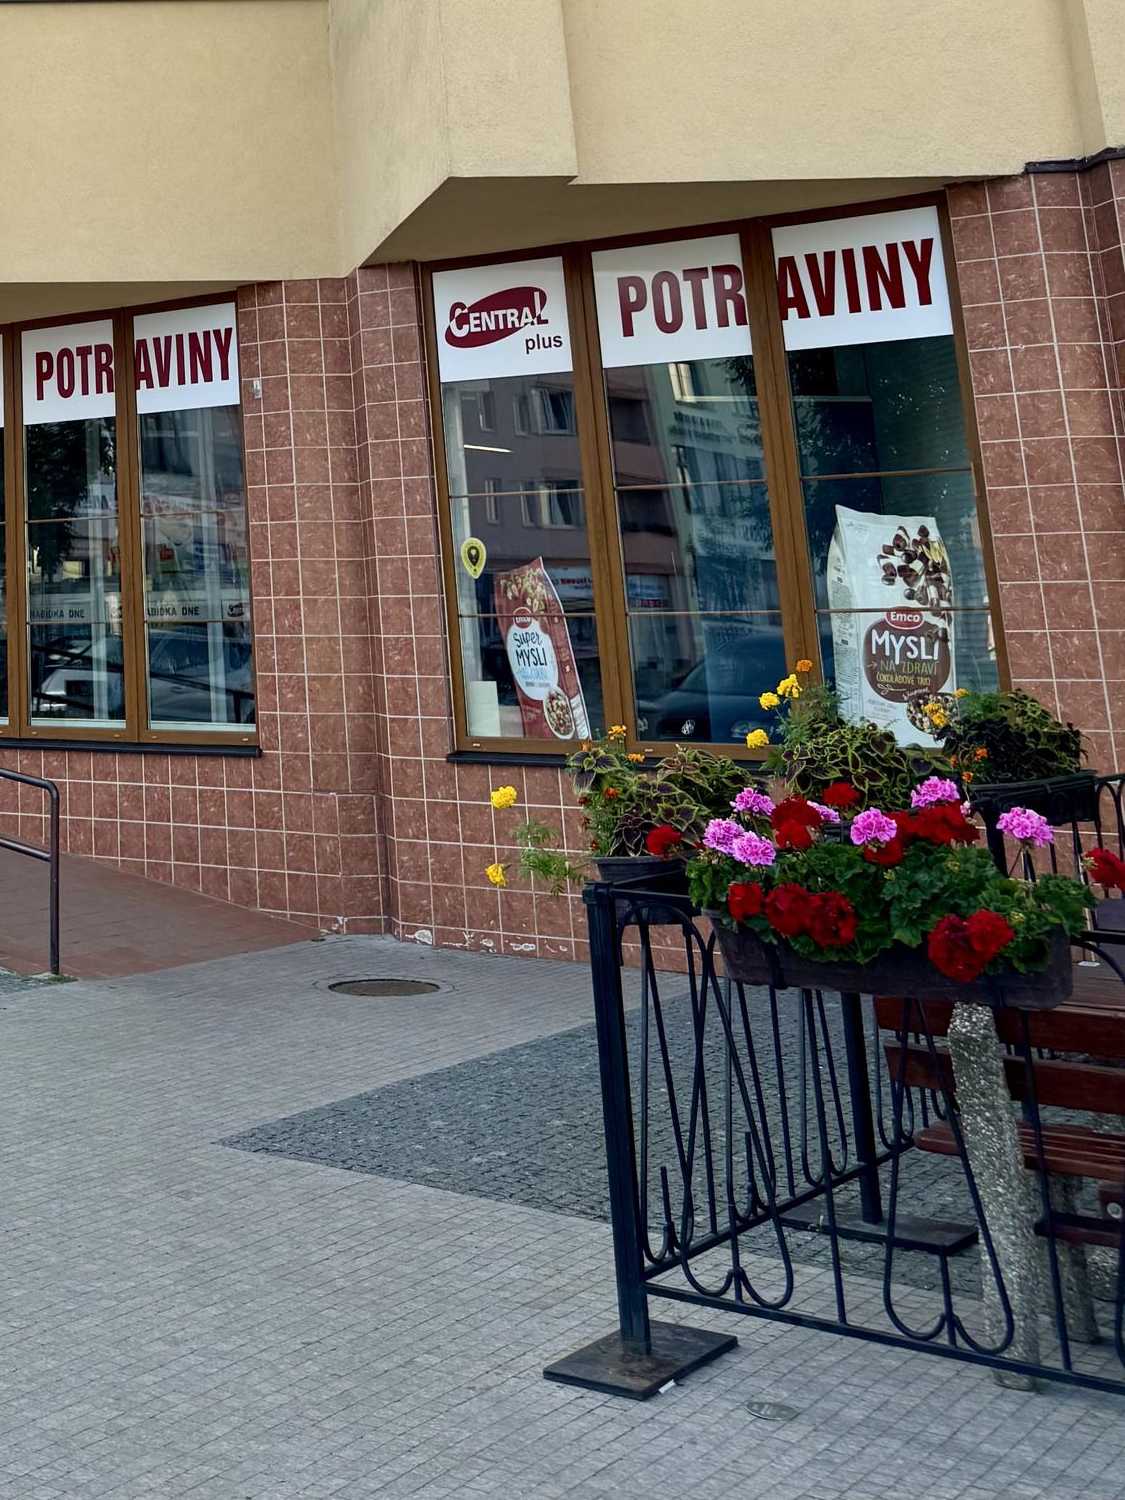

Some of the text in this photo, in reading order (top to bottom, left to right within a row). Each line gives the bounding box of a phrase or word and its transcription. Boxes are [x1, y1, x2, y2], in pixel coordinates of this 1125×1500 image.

[449, 290, 549, 338] CENTRAL
[524, 332, 563, 354] plus
[182, 606, 200, 616] DNE
[890, 611, 921, 622] Emco
[513, 631, 543, 648] Super
[871, 629, 940, 665] MYSLI
[515, 647, 548, 668] MYSLI
[880, 661, 896, 672] NA
